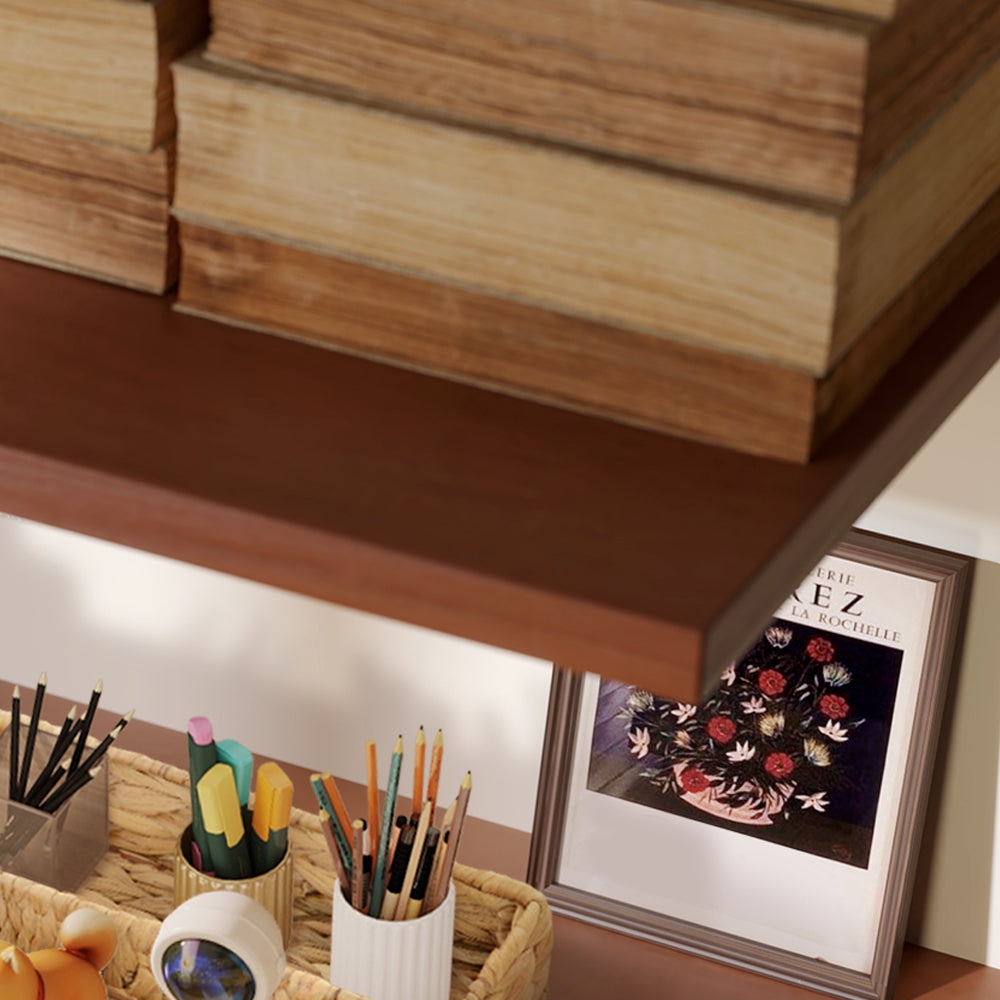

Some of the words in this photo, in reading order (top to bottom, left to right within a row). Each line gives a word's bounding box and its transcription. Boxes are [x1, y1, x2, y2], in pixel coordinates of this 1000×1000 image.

[816, 567, 855, 585] ERIE
[792, 583, 865, 617] EZ
[790, 605, 810, 620] LA
[818, 612, 902, 643] ROCHELLE
